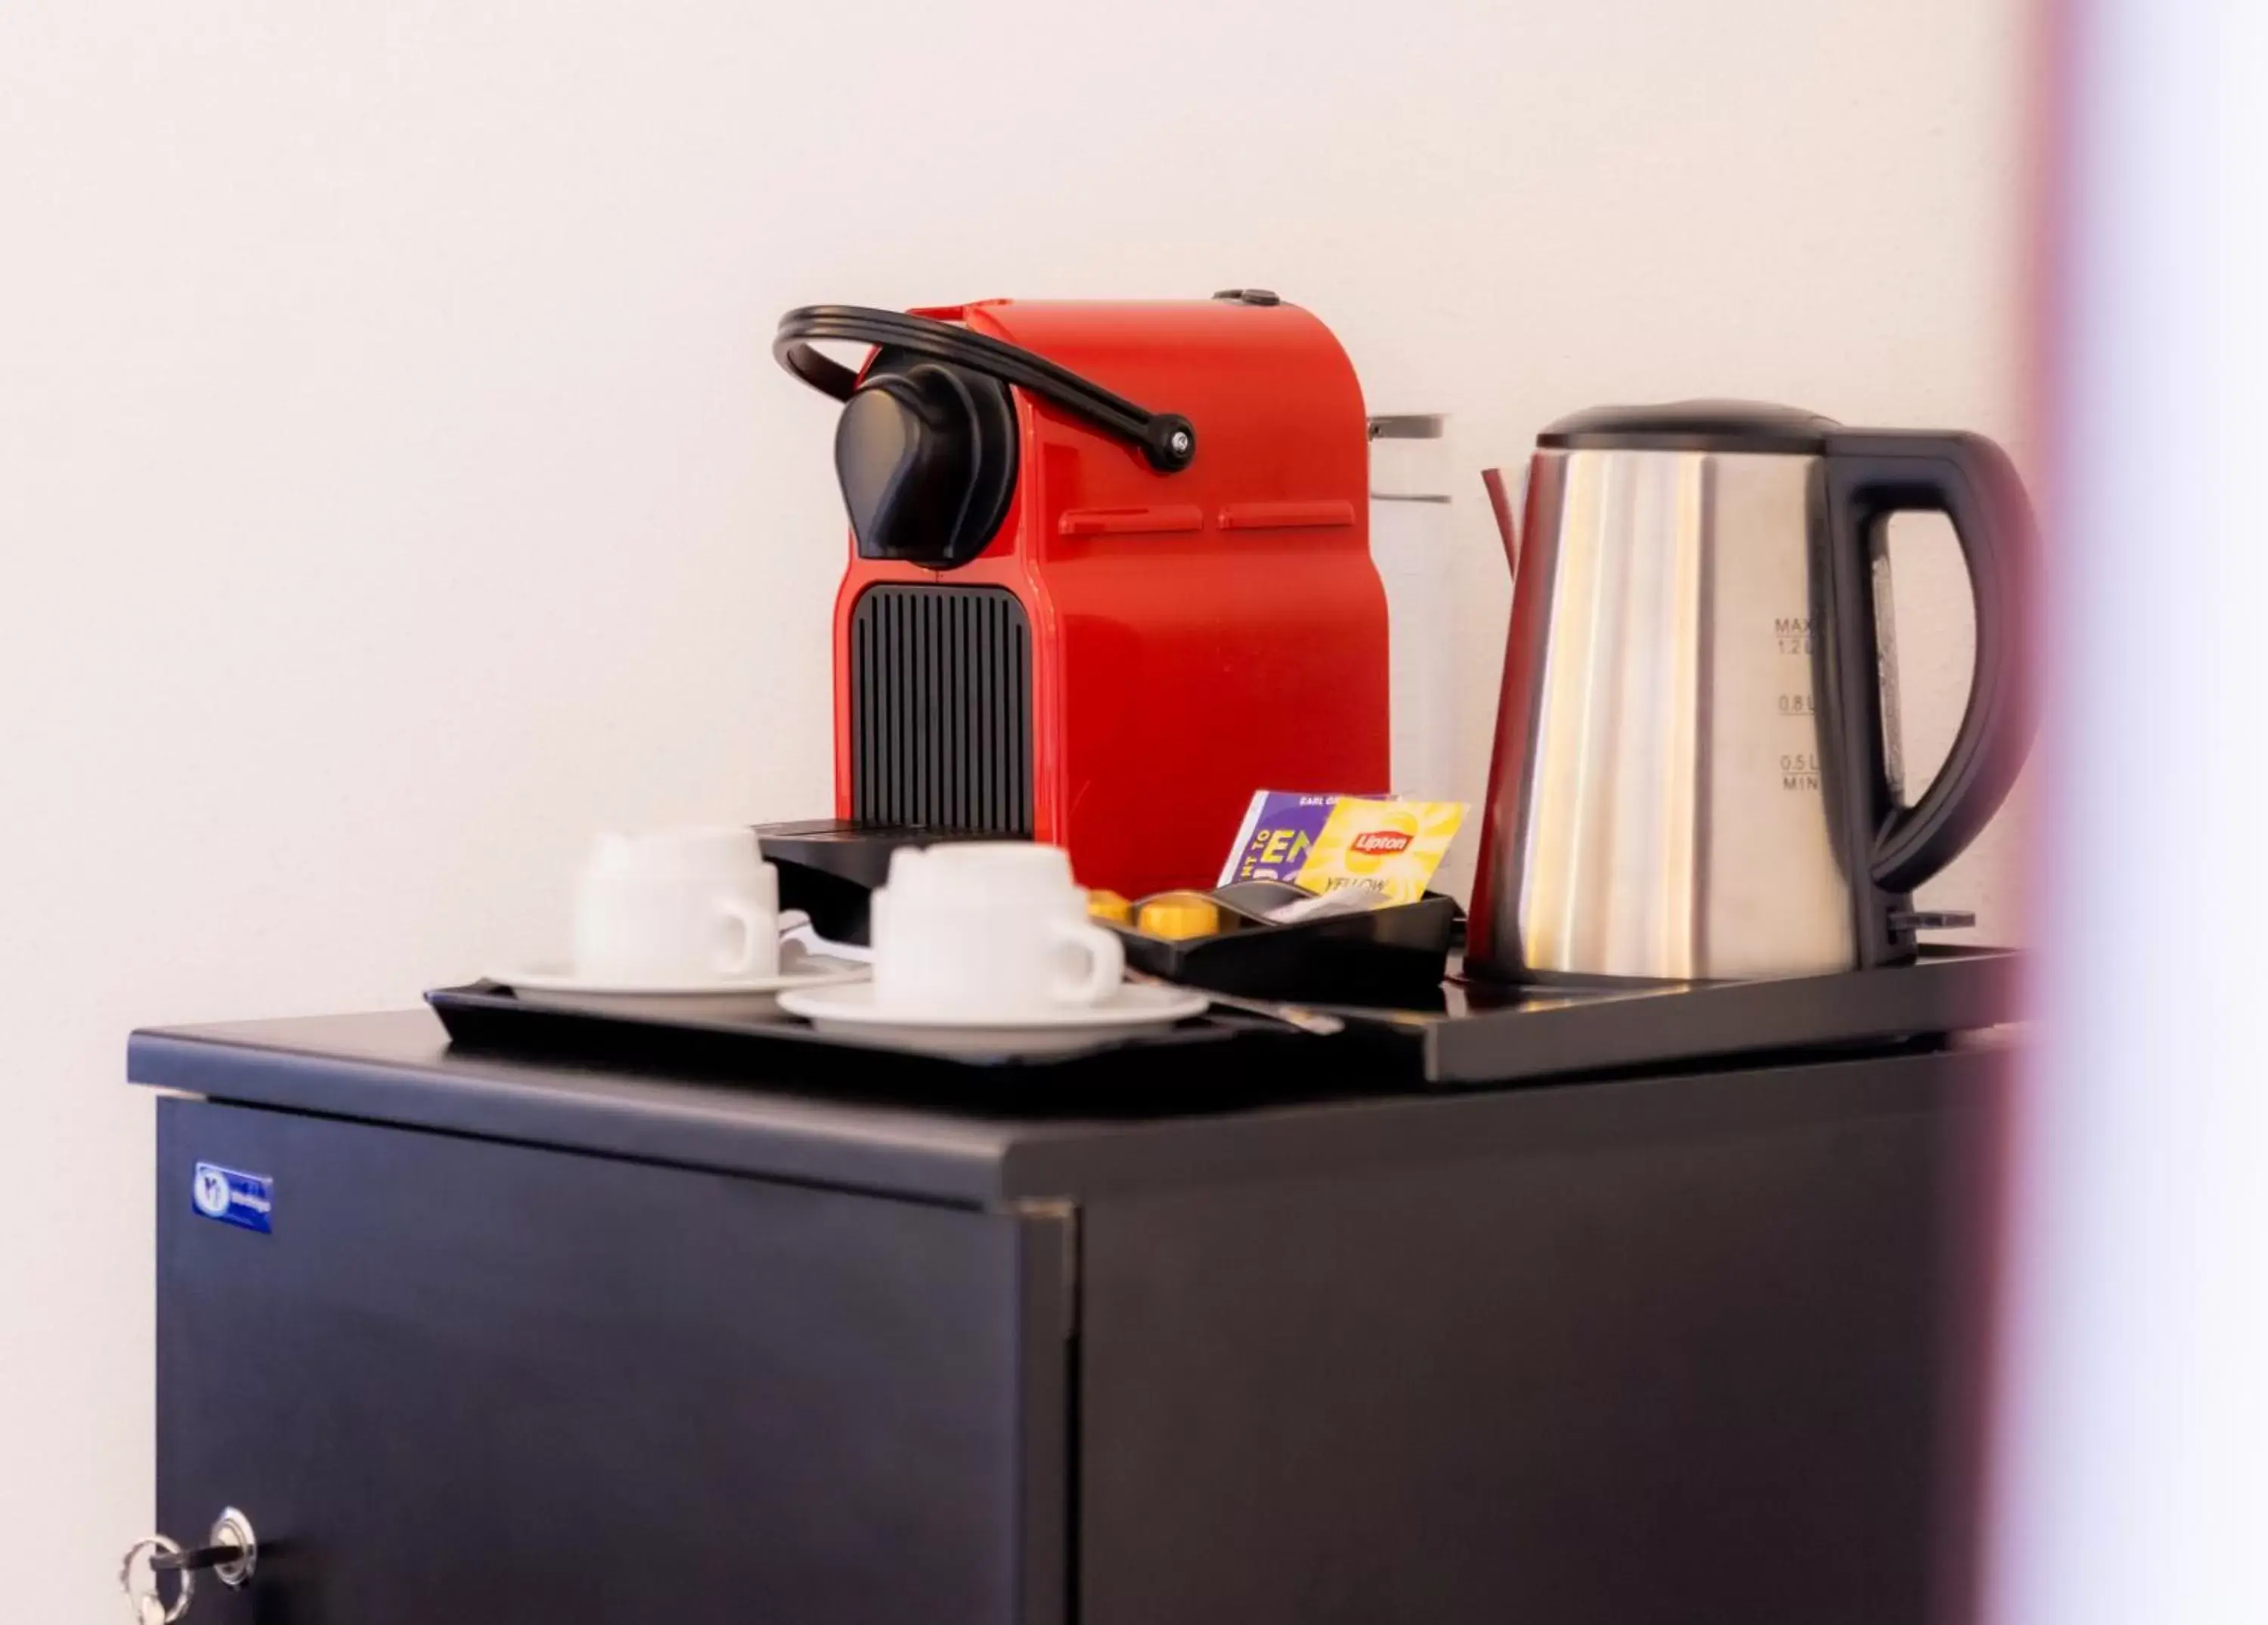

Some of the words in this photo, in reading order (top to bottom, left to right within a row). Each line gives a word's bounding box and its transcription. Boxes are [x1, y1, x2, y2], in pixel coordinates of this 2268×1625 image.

[1774, 618, 1815, 633] MAX
[1783, 776, 1819, 791] MIN
[1300, 797, 1325, 806] EARL
[1251, 830, 1271, 850] TO
[1355, 833, 1407, 852] Lipton
